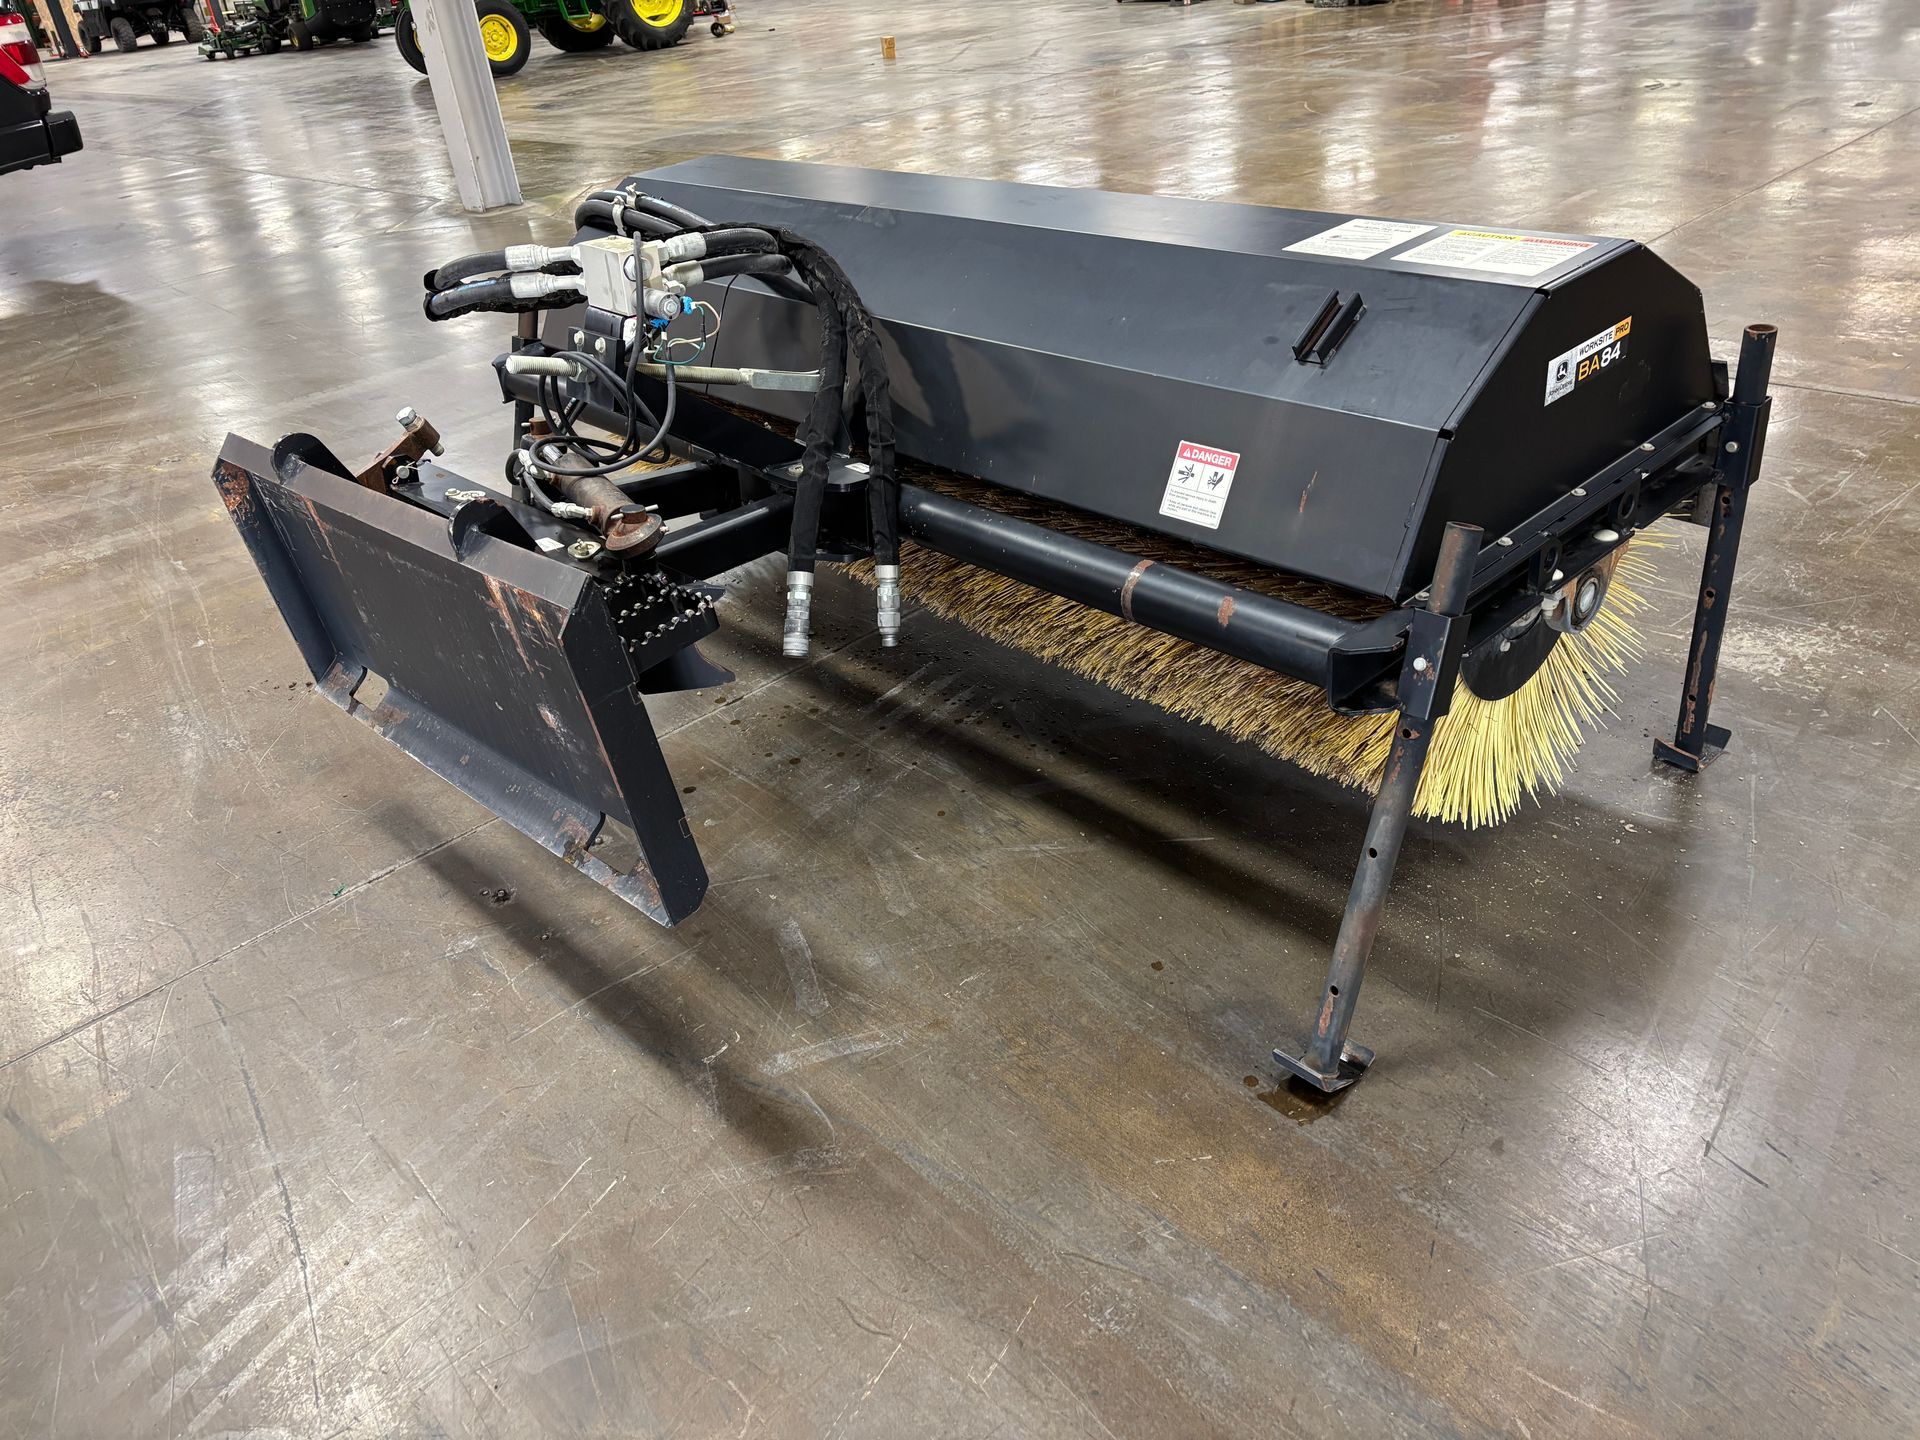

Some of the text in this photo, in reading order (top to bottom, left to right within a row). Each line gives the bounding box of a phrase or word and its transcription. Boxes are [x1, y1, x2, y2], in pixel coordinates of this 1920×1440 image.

[1467, 231, 1516, 240] CAUTION
[1531, 238, 1592, 248] WARNING
[1579, 321, 1629, 356] WORKSITE PRO
[1578, 341, 1621, 381] BA84
[1191, 448, 1232, 468] DANGER
